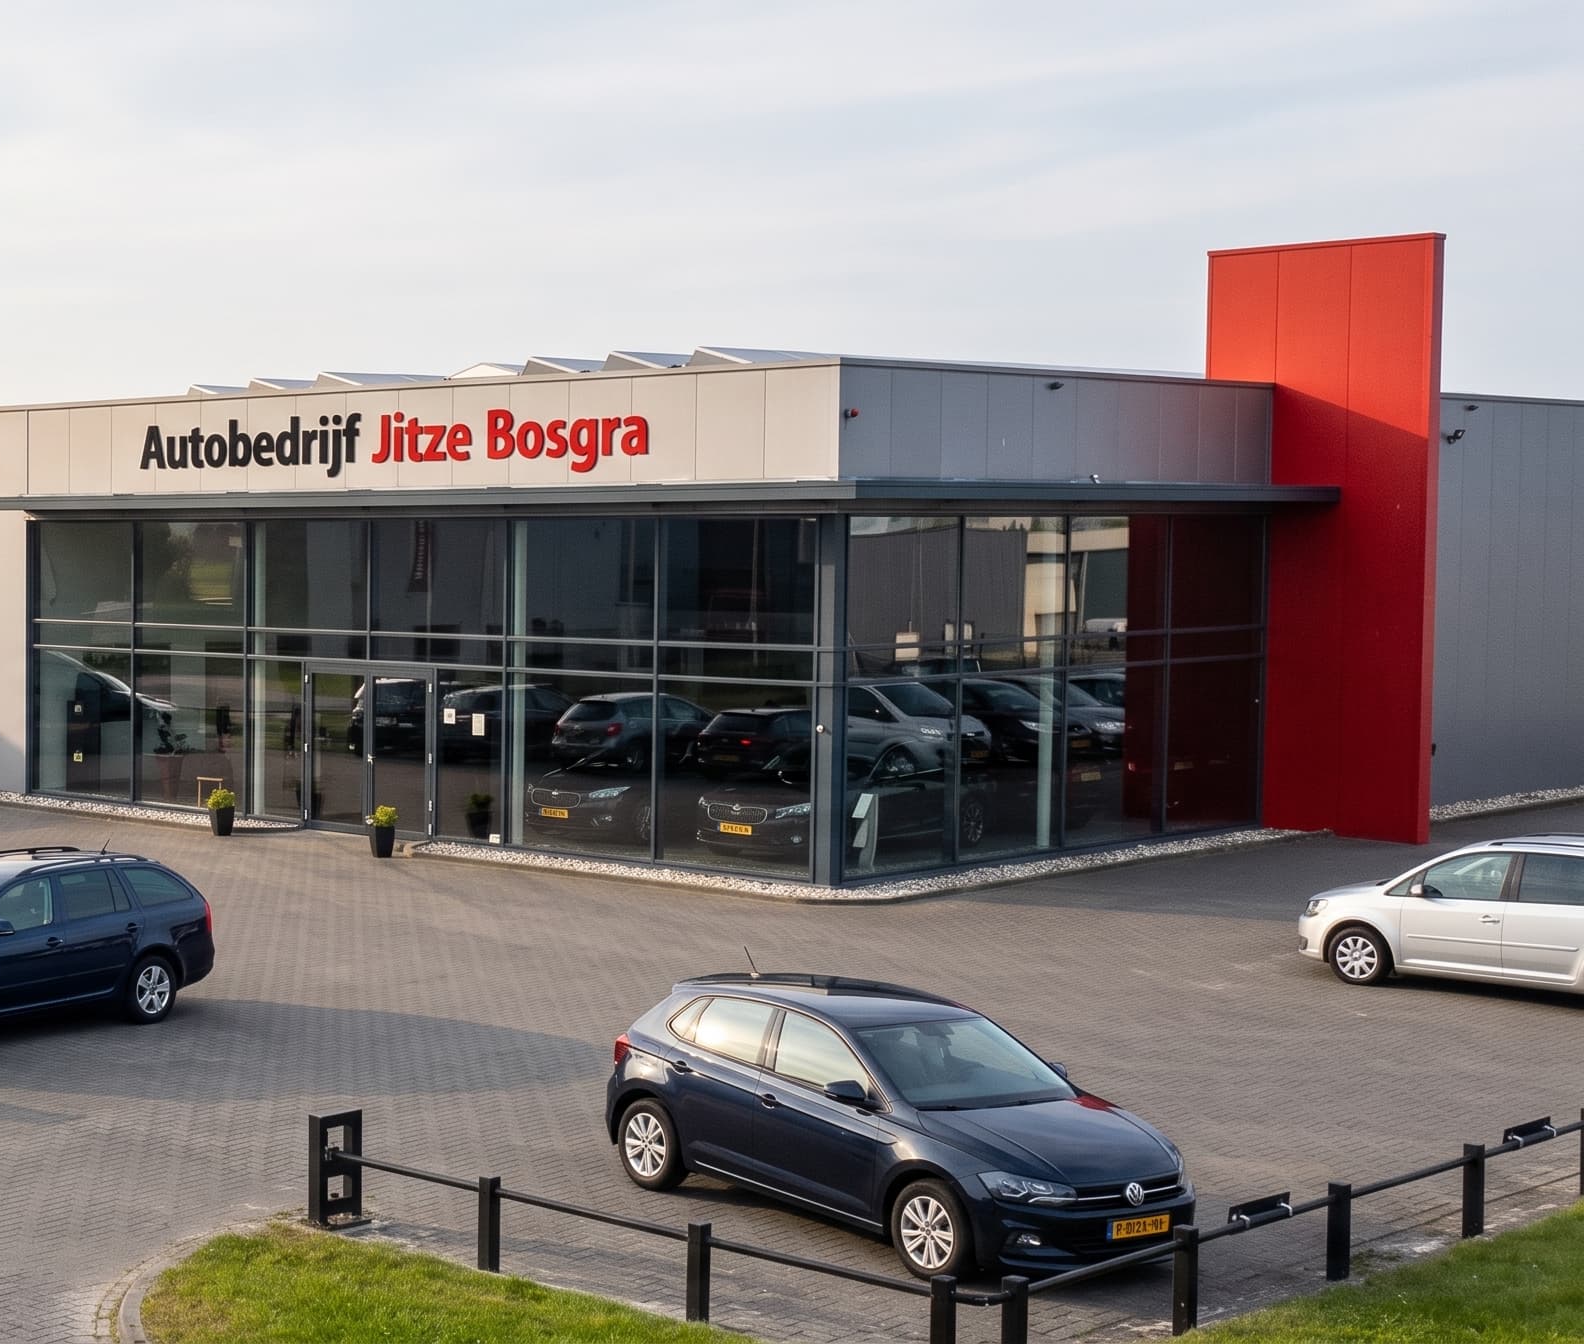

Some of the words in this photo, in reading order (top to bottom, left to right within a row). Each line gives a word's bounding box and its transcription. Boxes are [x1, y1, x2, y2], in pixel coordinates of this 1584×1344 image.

[140, 413, 361, 477] Autobedrijf
[371, 411, 471, 463] Jitze
[486, 408, 648, 472] Bosgra
